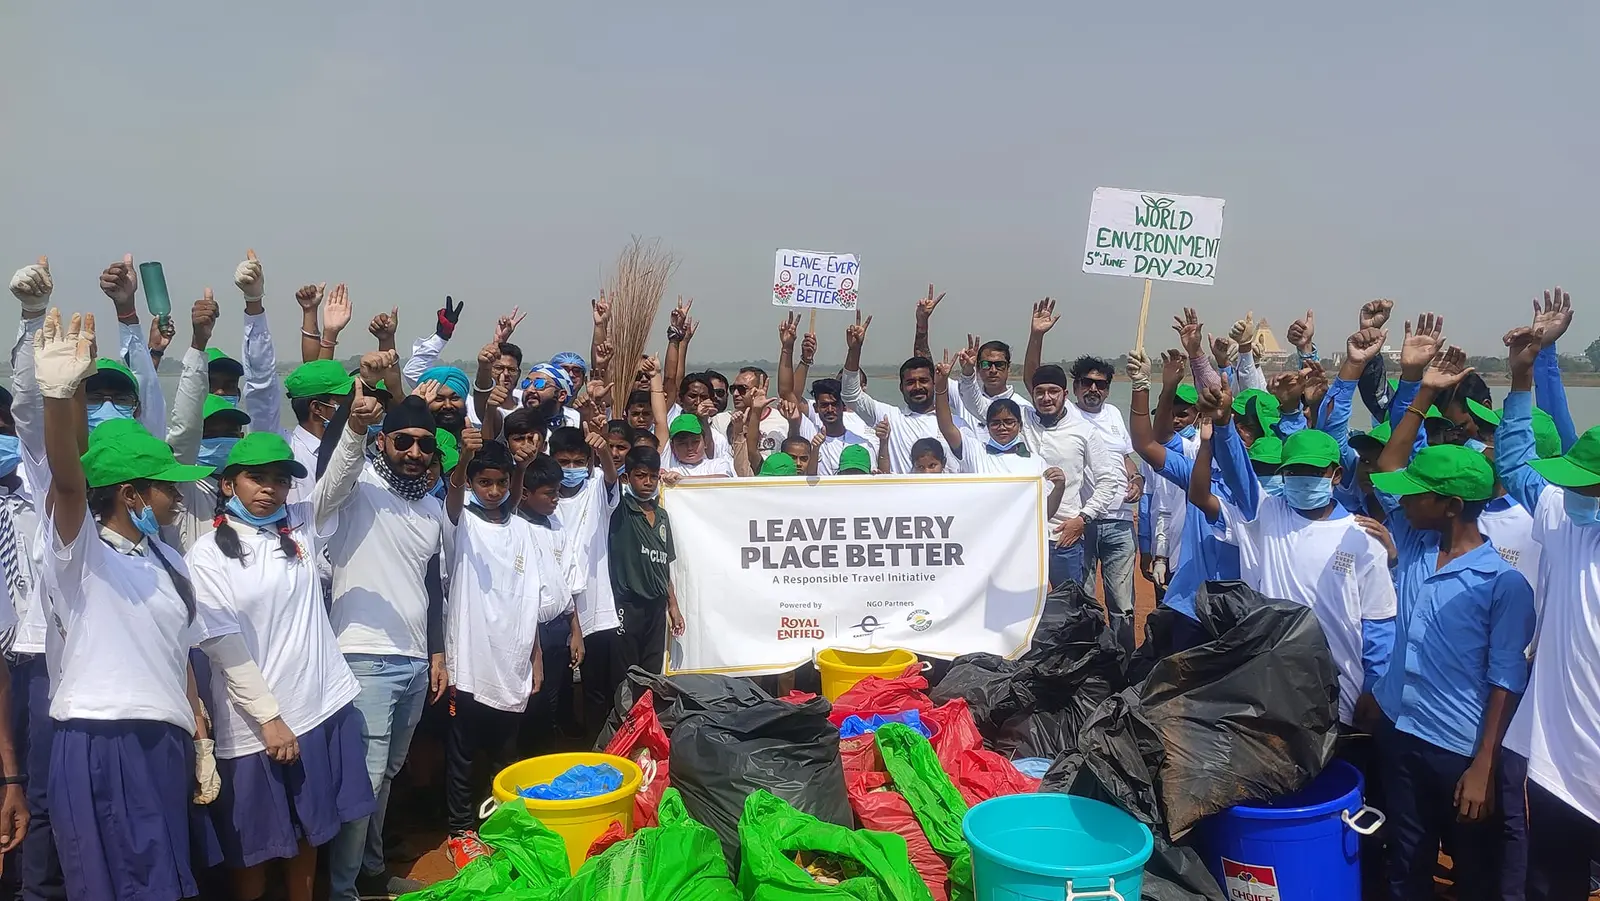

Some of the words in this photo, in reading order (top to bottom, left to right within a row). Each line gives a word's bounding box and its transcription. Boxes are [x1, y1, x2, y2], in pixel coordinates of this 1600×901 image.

[1135, 205, 1193, 231] WORLD
[1096, 227, 1220, 258] ENVIRONMENT
[783, 255, 821, 271] LEAVE
[827, 256, 860, 275] EVERY
[1100, 253, 1127, 268] JUNE
[1134, 254, 1172, 277] DAY
[1173, 260, 1214, 279] 2022
[798, 273, 836, 290] PLACE
[797, 289, 840, 304] BETTER
[749, 518, 847, 542] LEAVE
[853, 516, 955, 540] EVERY
[741, 545, 839, 569] PLACE
[846, 543, 965, 567] BETTER
[1499, 546, 1520, 556] LEAVE
[772, 576, 780, 584] A
[783, 573, 849, 586] Responsible
[852, 573, 885, 583] Travel
[888, 572, 936, 582] Initiative
[781, 617, 819, 629] ROYAL
[777, 630, 825, 640] ENFIELD
